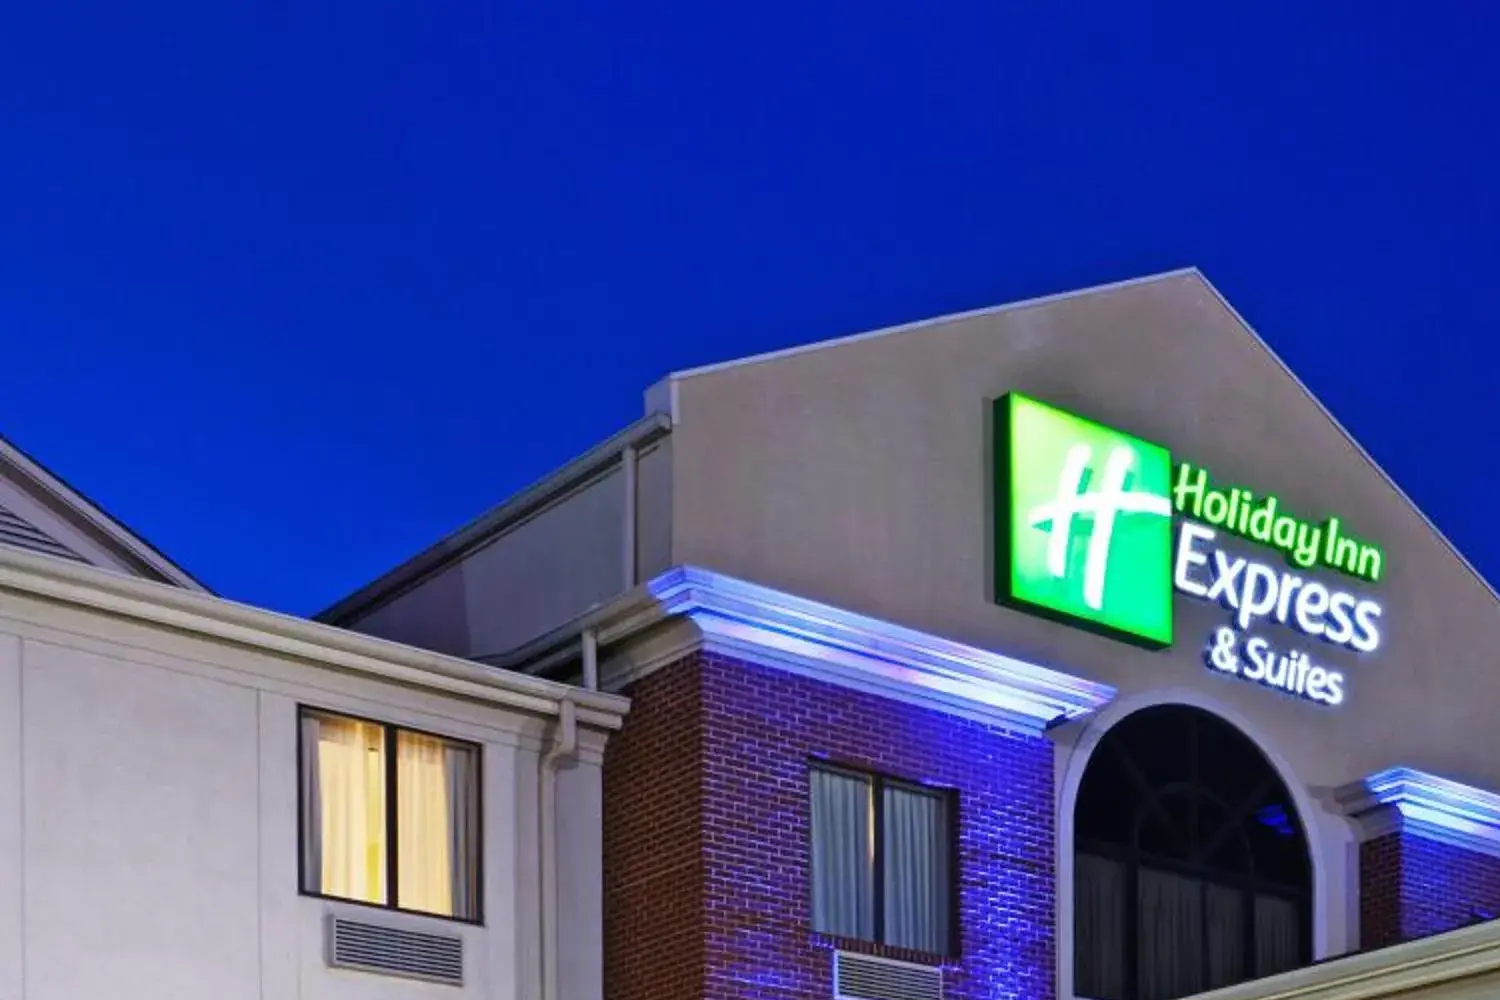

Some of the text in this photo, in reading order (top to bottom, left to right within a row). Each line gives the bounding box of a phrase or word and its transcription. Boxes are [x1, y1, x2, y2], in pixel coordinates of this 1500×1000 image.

[1173, 462, 1382, 581] Holiday Inn
[1175, 521, 1382, 652] Express
[1211, 626, 1345, 705] & Suites
